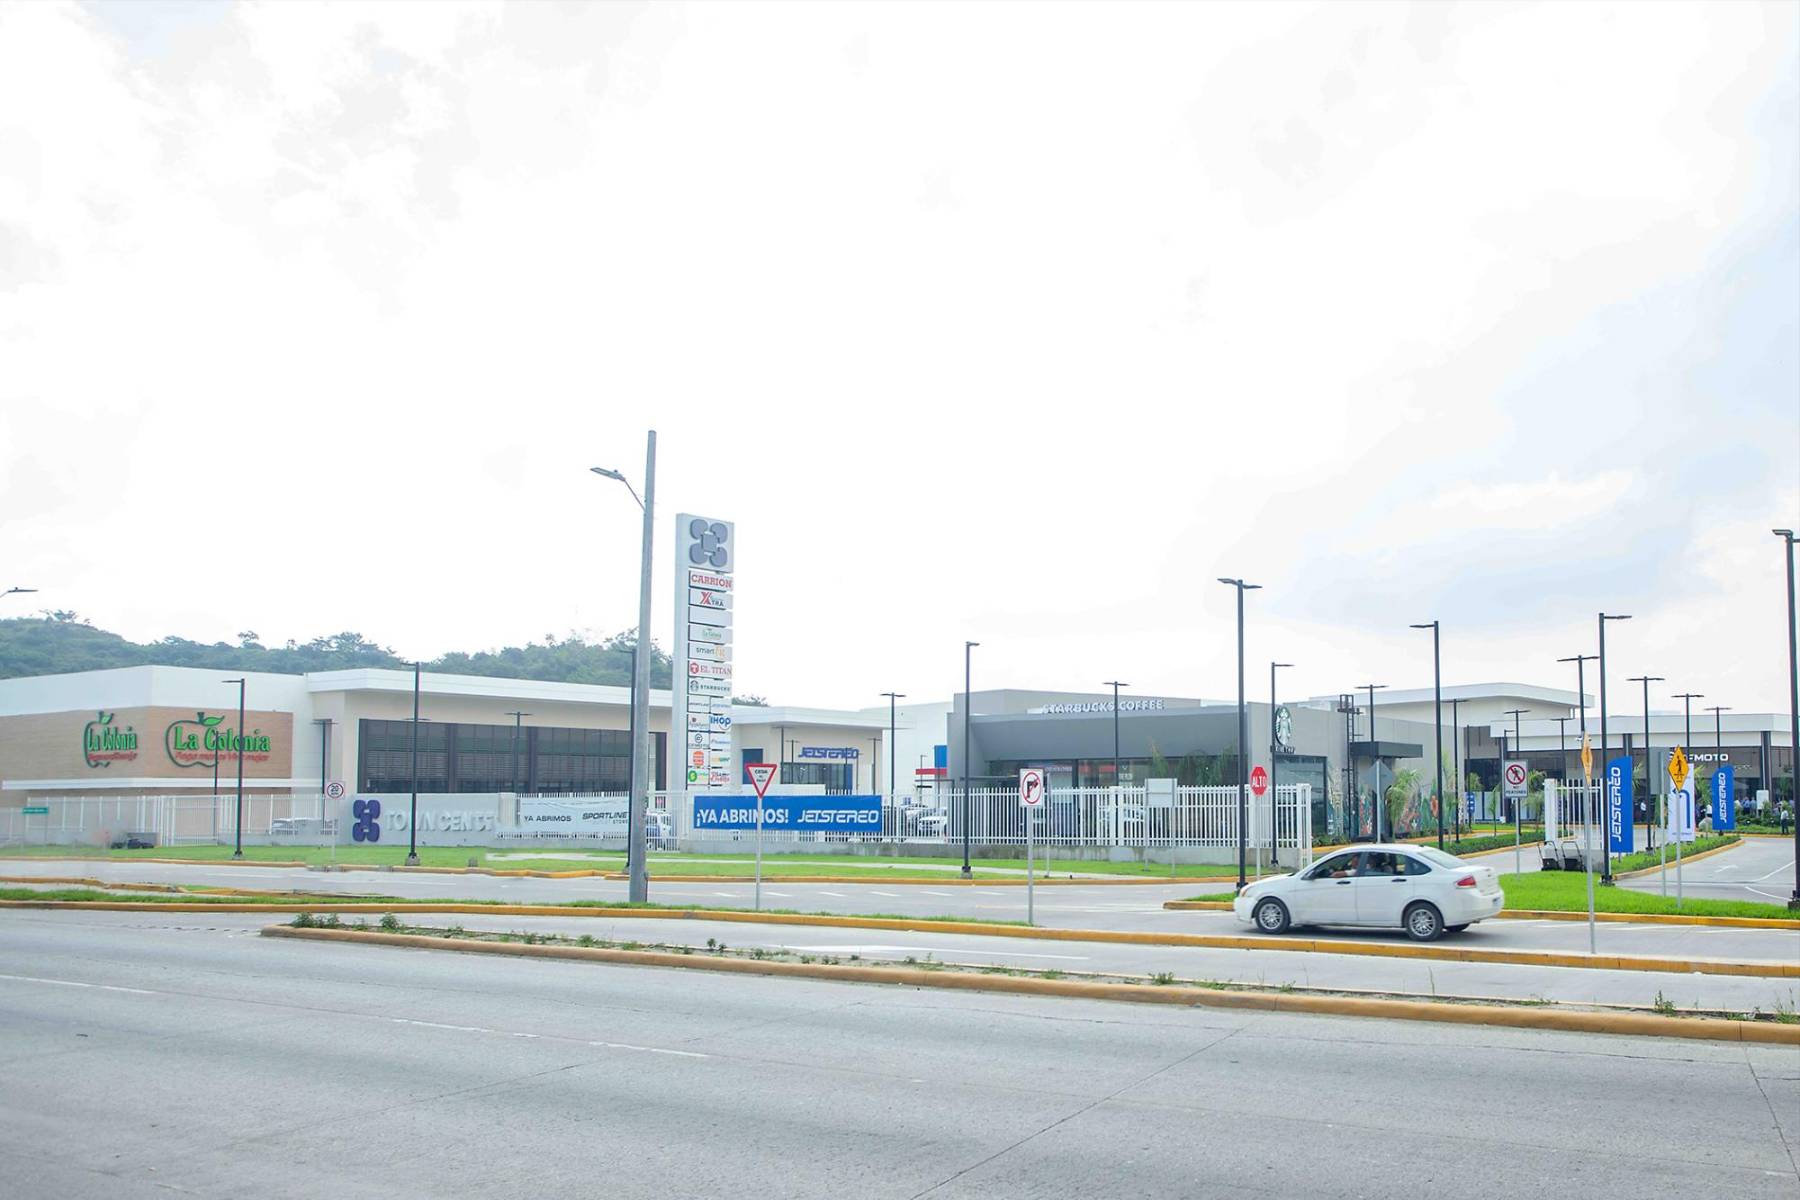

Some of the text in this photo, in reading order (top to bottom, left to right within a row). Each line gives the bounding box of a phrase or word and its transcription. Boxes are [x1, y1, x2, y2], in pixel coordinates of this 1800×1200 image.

[691, 574, 732, 588] CARRION
[1041, 699, 1166, 714] STARBUCKS COFFEE
[101, 726, 137, 750] Colonia
[174, 726, 271, 752] La Colonia
[1252, 776, 1266, 787] ALTO
[582, 812, 629, 821] SPORTLINE
[797, 810, 879, 823] JETSTEREO
